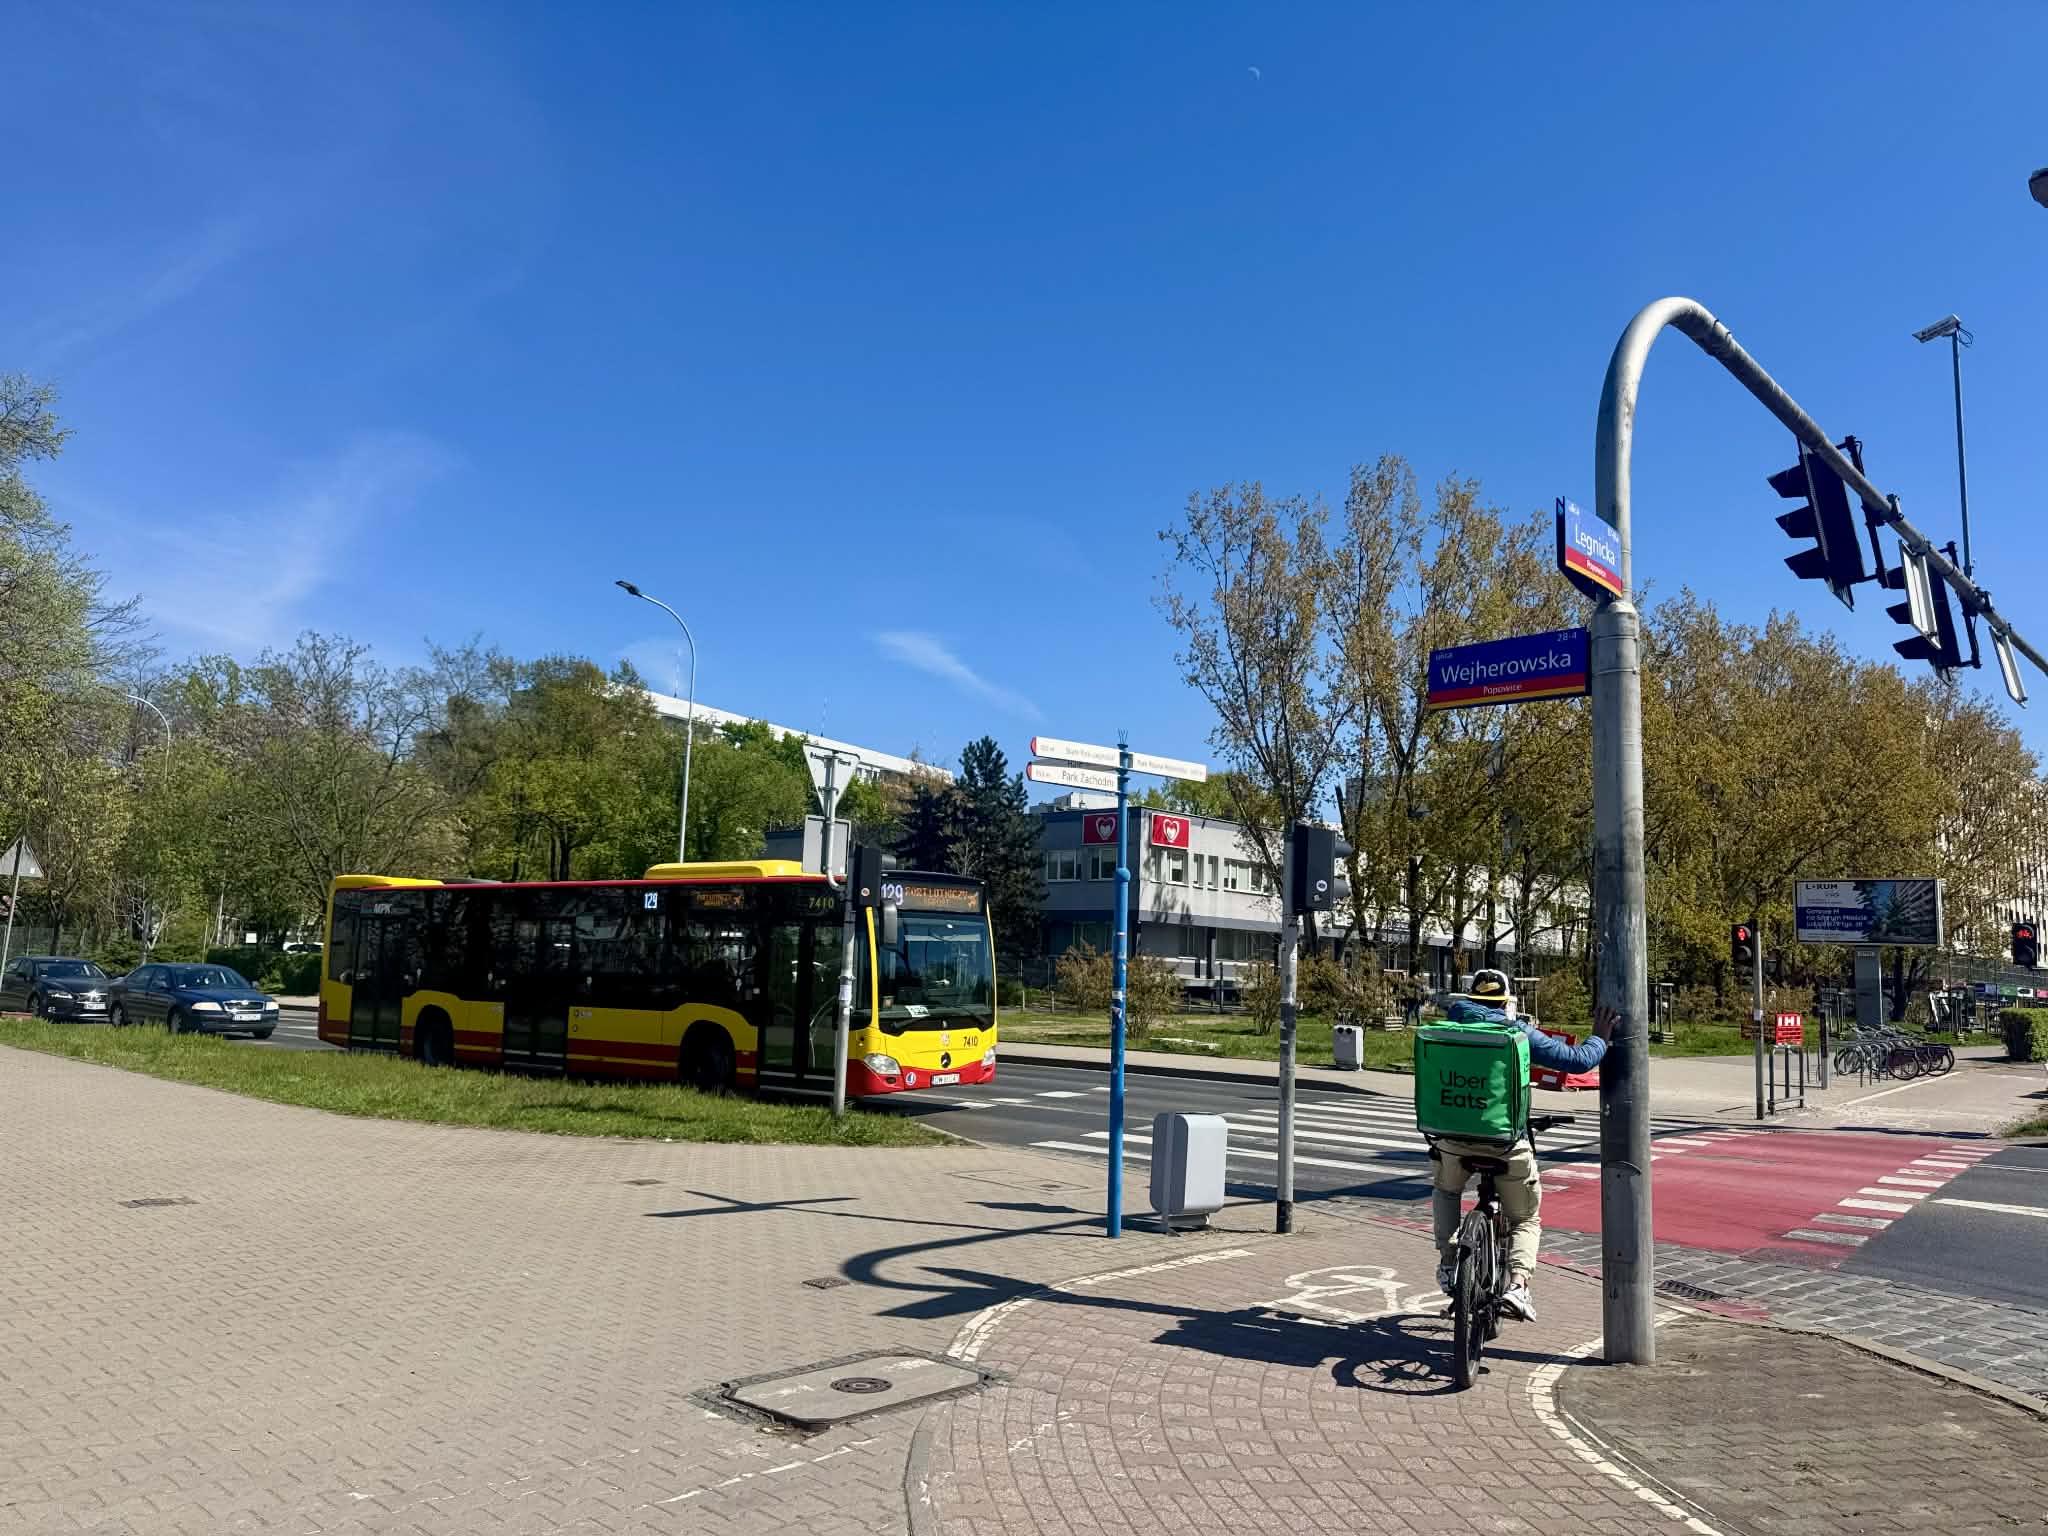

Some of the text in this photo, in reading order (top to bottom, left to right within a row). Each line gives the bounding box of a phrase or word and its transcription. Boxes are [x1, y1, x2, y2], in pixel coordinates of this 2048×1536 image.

[1575, 523, 1615, 565] Legnicka
[1441, 649, 1572, 685] Wejherowska
[1483, 684, 1522, 697] Popowice
[1062, 768, 1079, 784] Park
[644, 892, 658, 909] 129
[808, 896, 834, 909] 7410
[881, 883, 903, 905] 129
[963, 1036, 978, 1047] 7410
[1439, 1068, 1488, 1088] Uber
[1440, 1089, 1488, 1109] Eats
